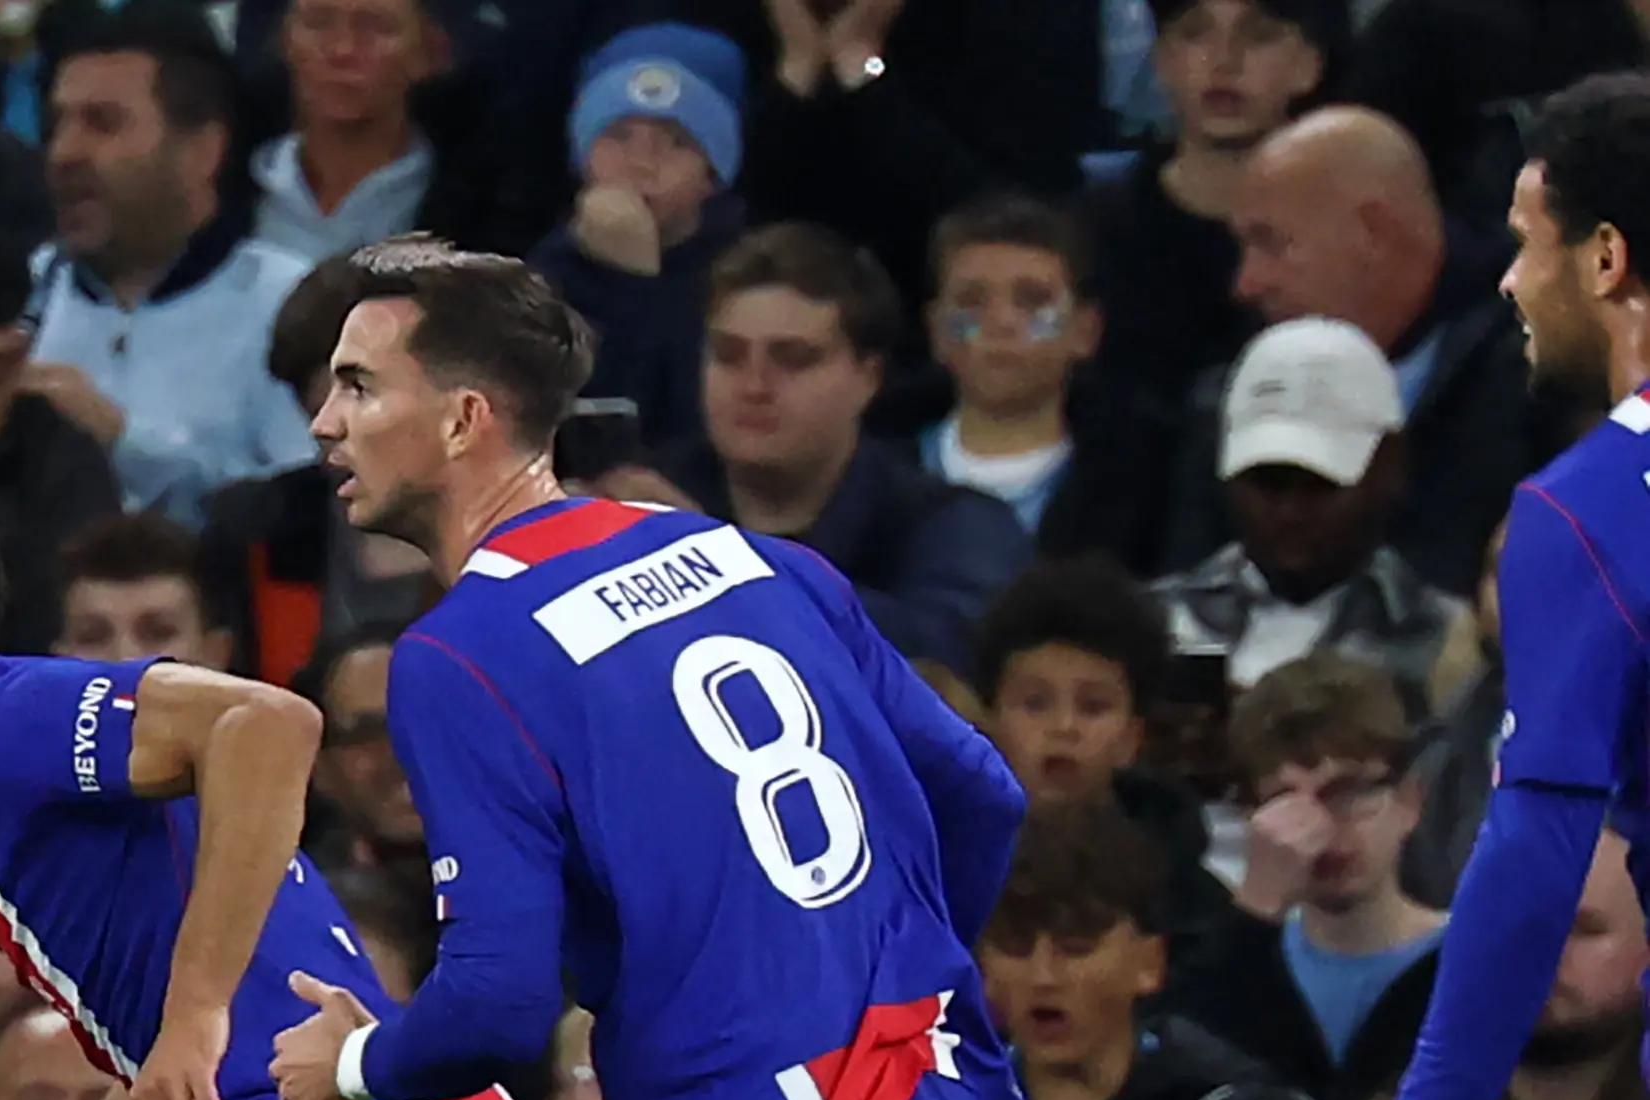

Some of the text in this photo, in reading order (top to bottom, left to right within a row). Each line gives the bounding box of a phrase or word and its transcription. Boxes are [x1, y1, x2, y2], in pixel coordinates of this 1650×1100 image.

[593, 546, 725, 622] FABIAN
[73, 676, 114, 792] BEYOND
[672, 634, 872, 909] 8
